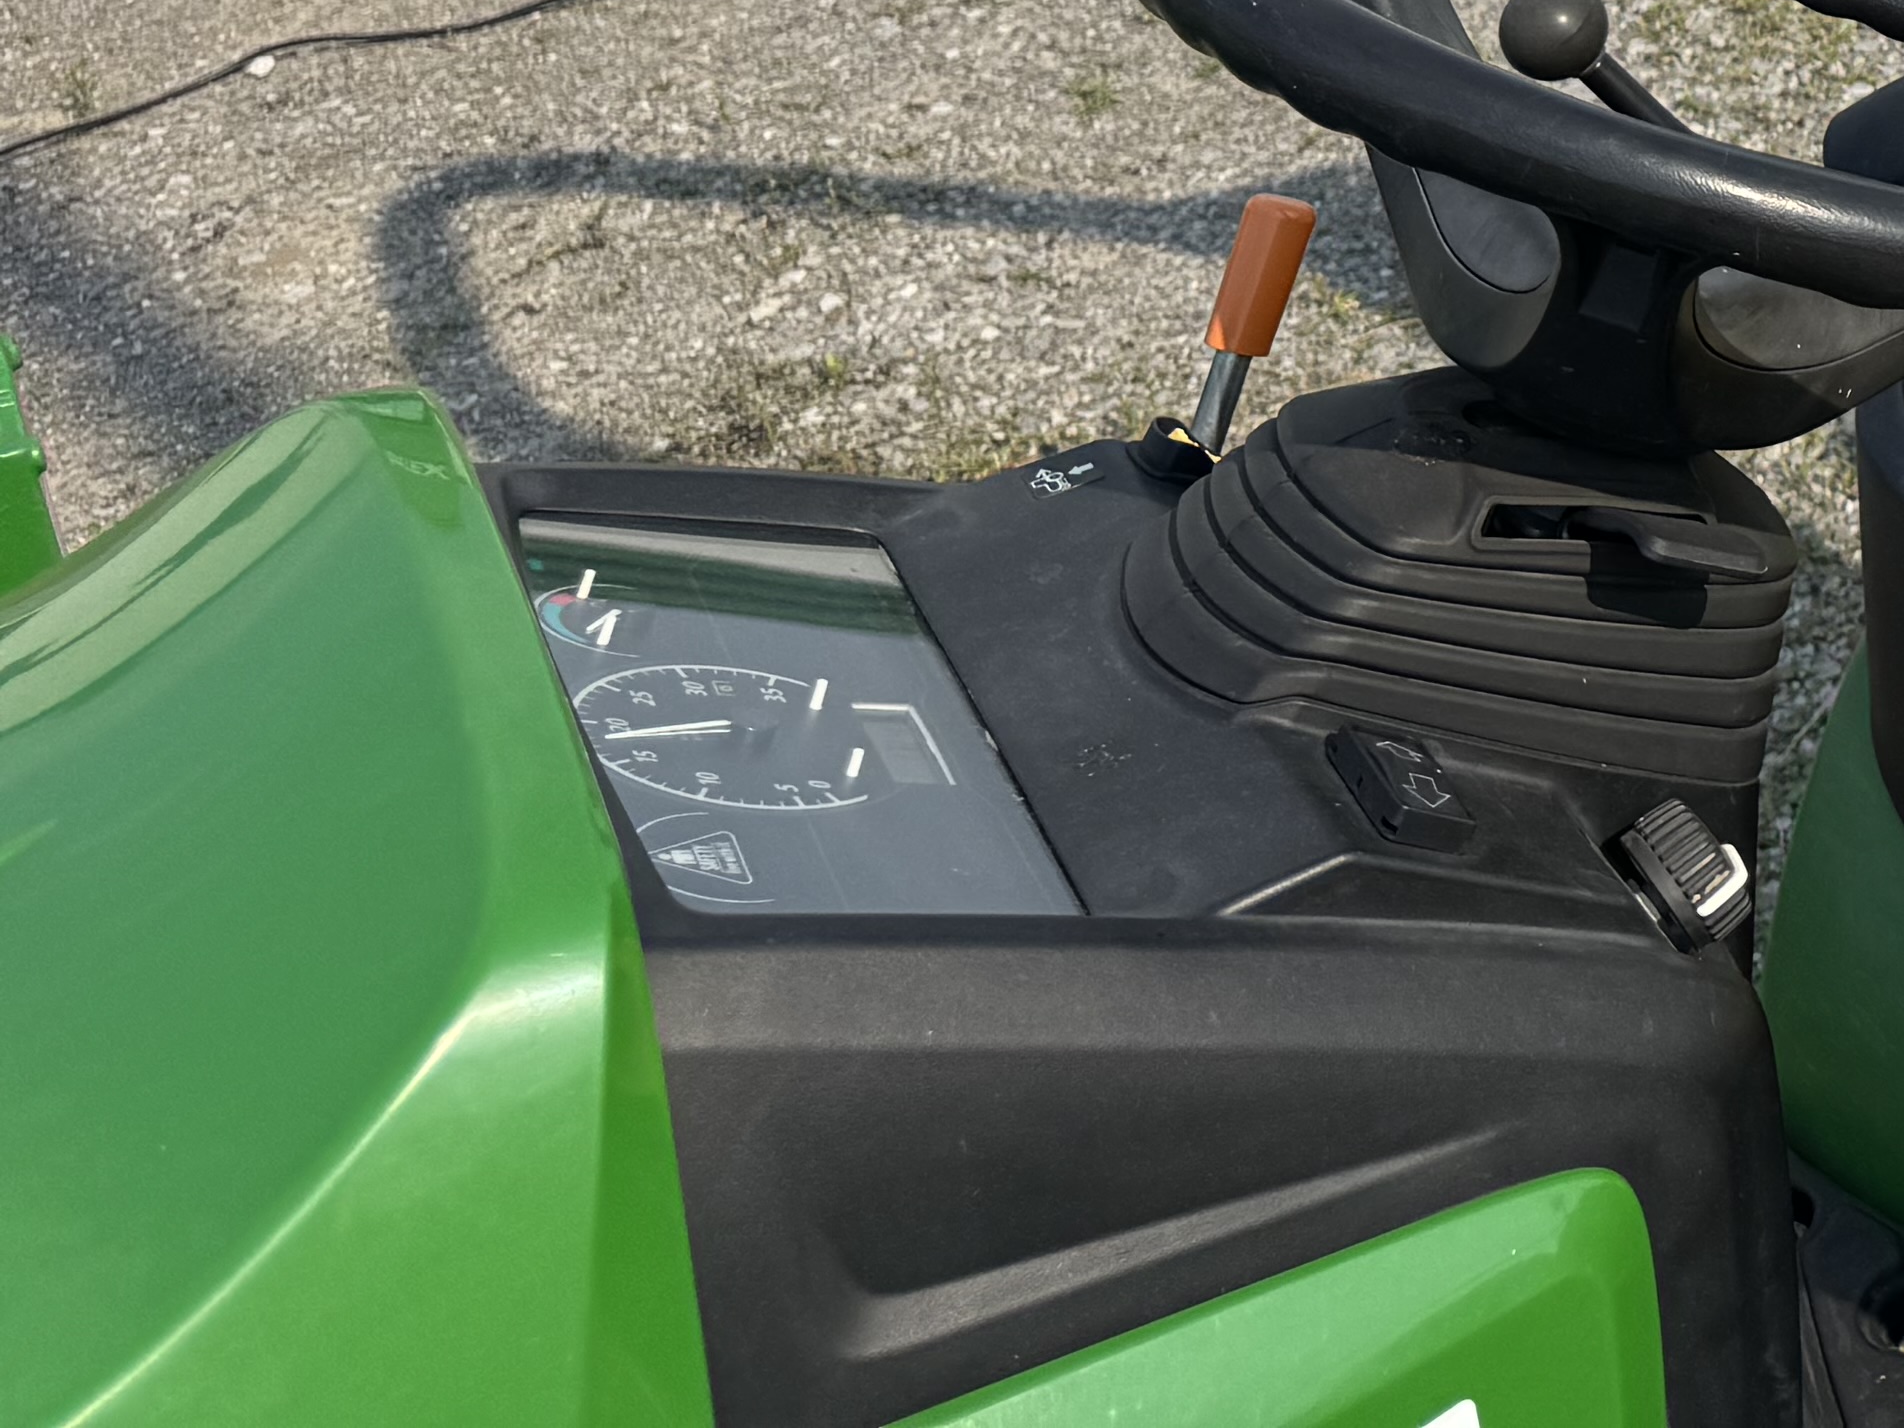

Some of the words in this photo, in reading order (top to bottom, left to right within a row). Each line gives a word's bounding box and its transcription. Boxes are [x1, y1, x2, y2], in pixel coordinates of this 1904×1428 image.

[681, 681, 708, 696] 30
[760, 687, 787, 704] 35
[631, 690, 657, 707] 25
[631, 749, 660, 764] 15
[695, 771, 722, 786] 10
